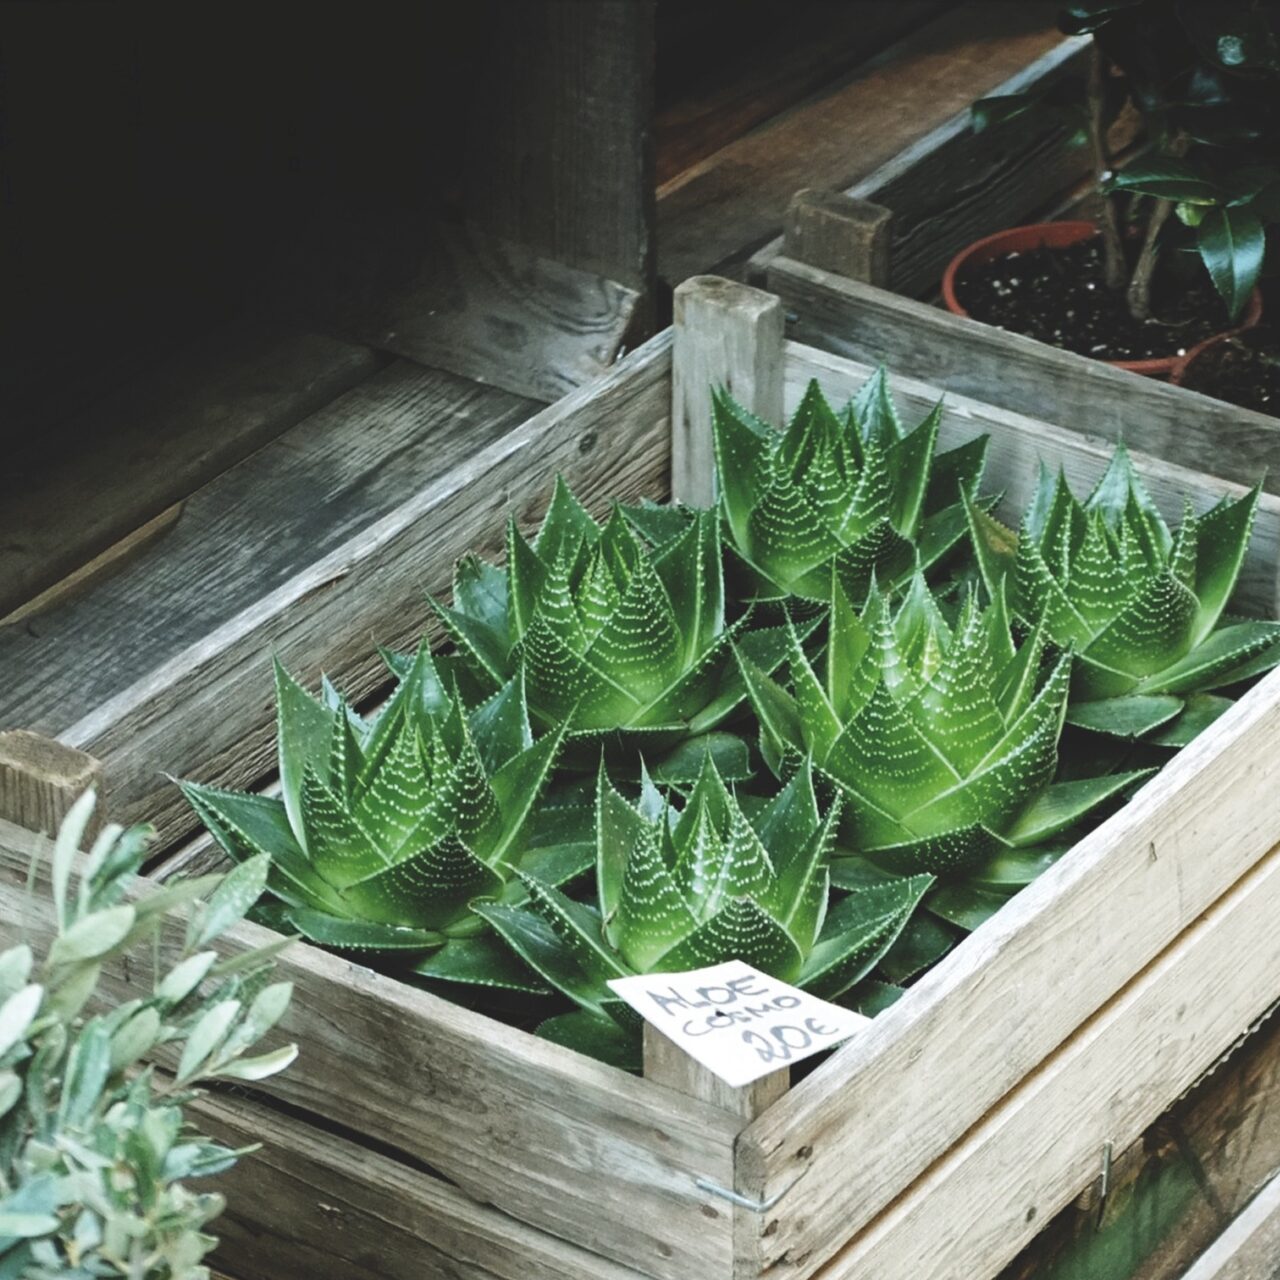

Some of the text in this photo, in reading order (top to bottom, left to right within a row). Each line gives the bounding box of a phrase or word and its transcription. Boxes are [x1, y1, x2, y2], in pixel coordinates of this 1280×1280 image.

[646, 975, 769, 1016] ALOE
[682, 995, 802, 1036] COSMO
[741, 1017, 839, 1063] 20€
